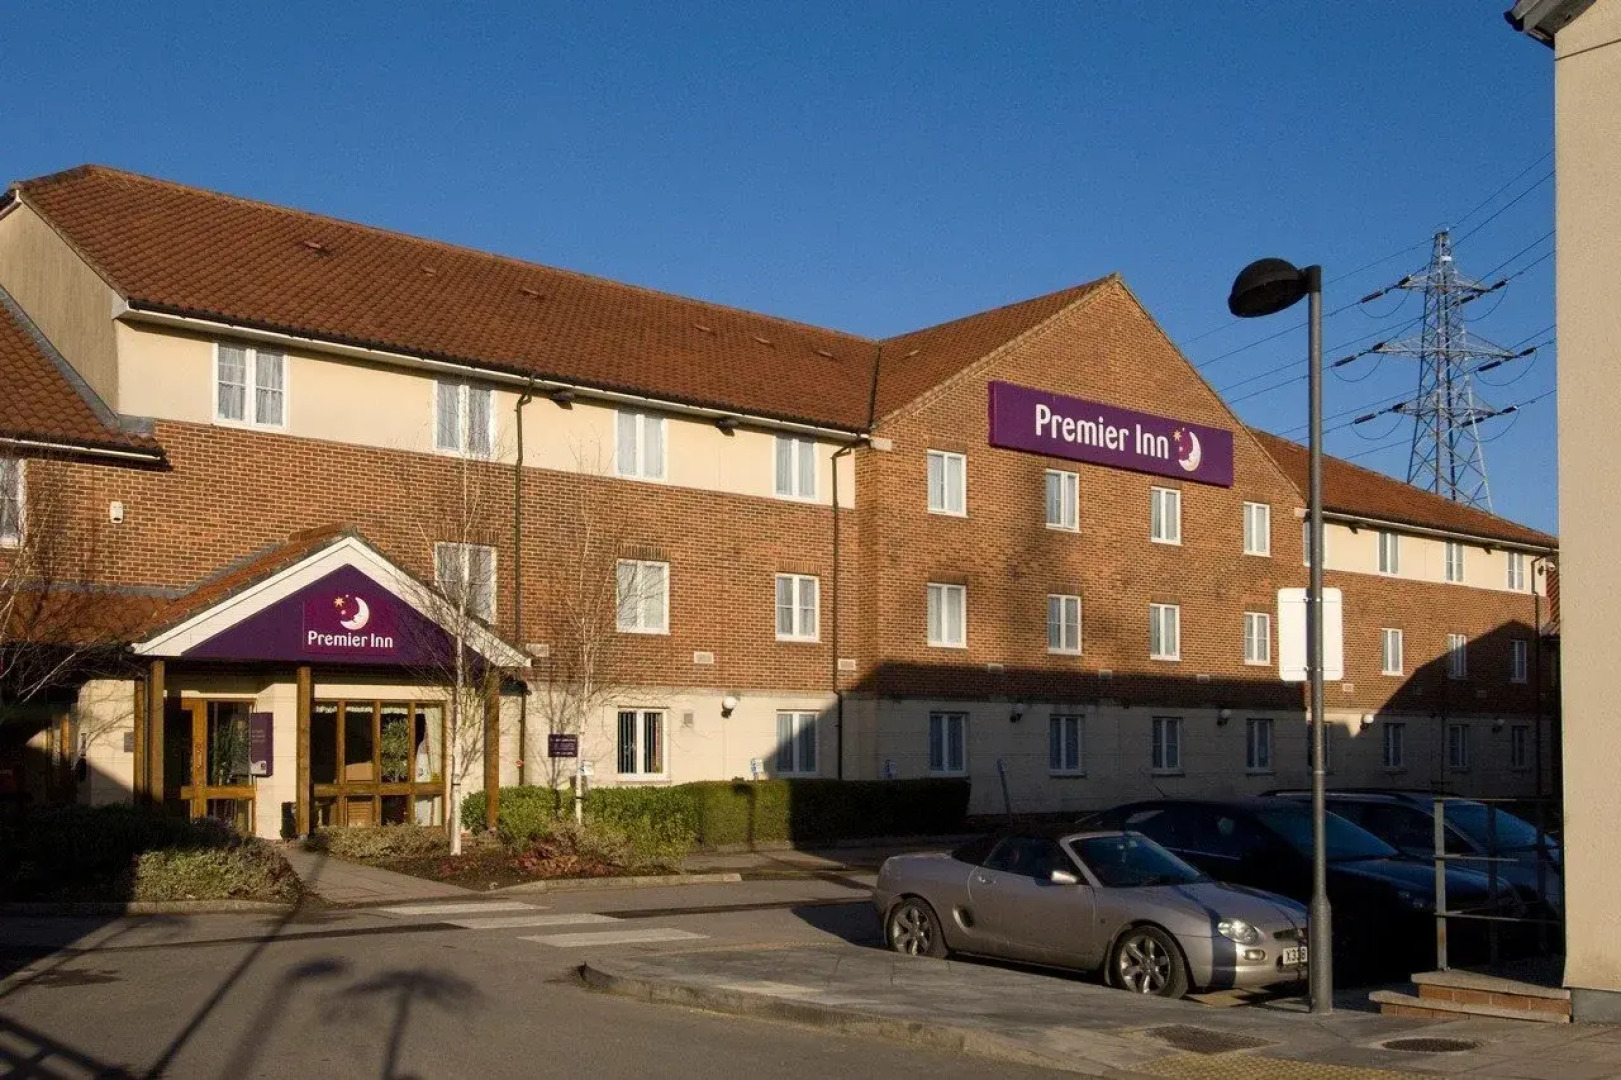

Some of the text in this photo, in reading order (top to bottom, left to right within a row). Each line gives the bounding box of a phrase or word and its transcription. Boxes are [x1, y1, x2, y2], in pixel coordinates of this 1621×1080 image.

[1035, 403, 1169, 459] Premier Inn
[308, 630, 393, 648] Premier Inn
